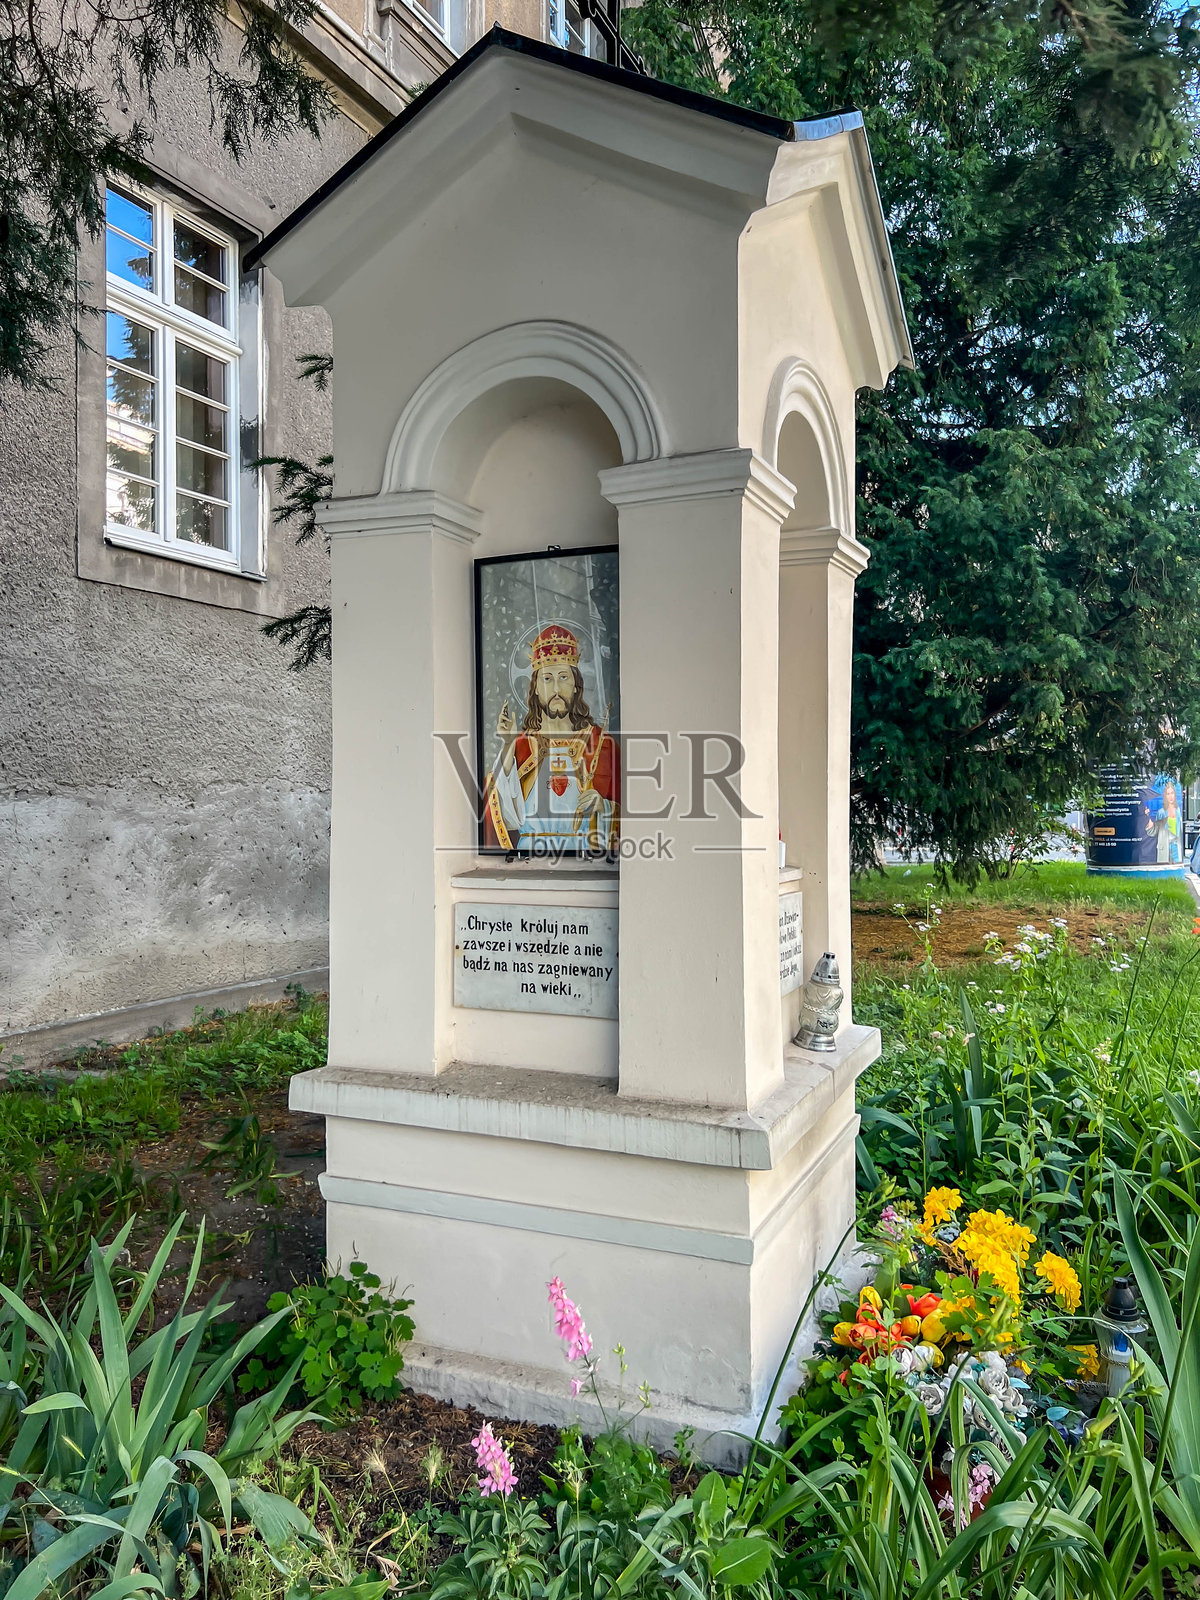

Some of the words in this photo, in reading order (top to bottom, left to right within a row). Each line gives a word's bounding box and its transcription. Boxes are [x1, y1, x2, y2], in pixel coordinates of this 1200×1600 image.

[562, 923, 589, 936] nam
[463, 939, 506, 952] zawsze
[508, 941, 512, 952] i
[515, 940, 570, 957] wszędzie
[574, 945, 582, 956] a
[584, 943, 603, 957] nie
[494, 960, 508, 973] na
[512, 960, 534, 974] nas
[538, 963, 614, 982] zagniewany
[520, 982, 537, 994] na
